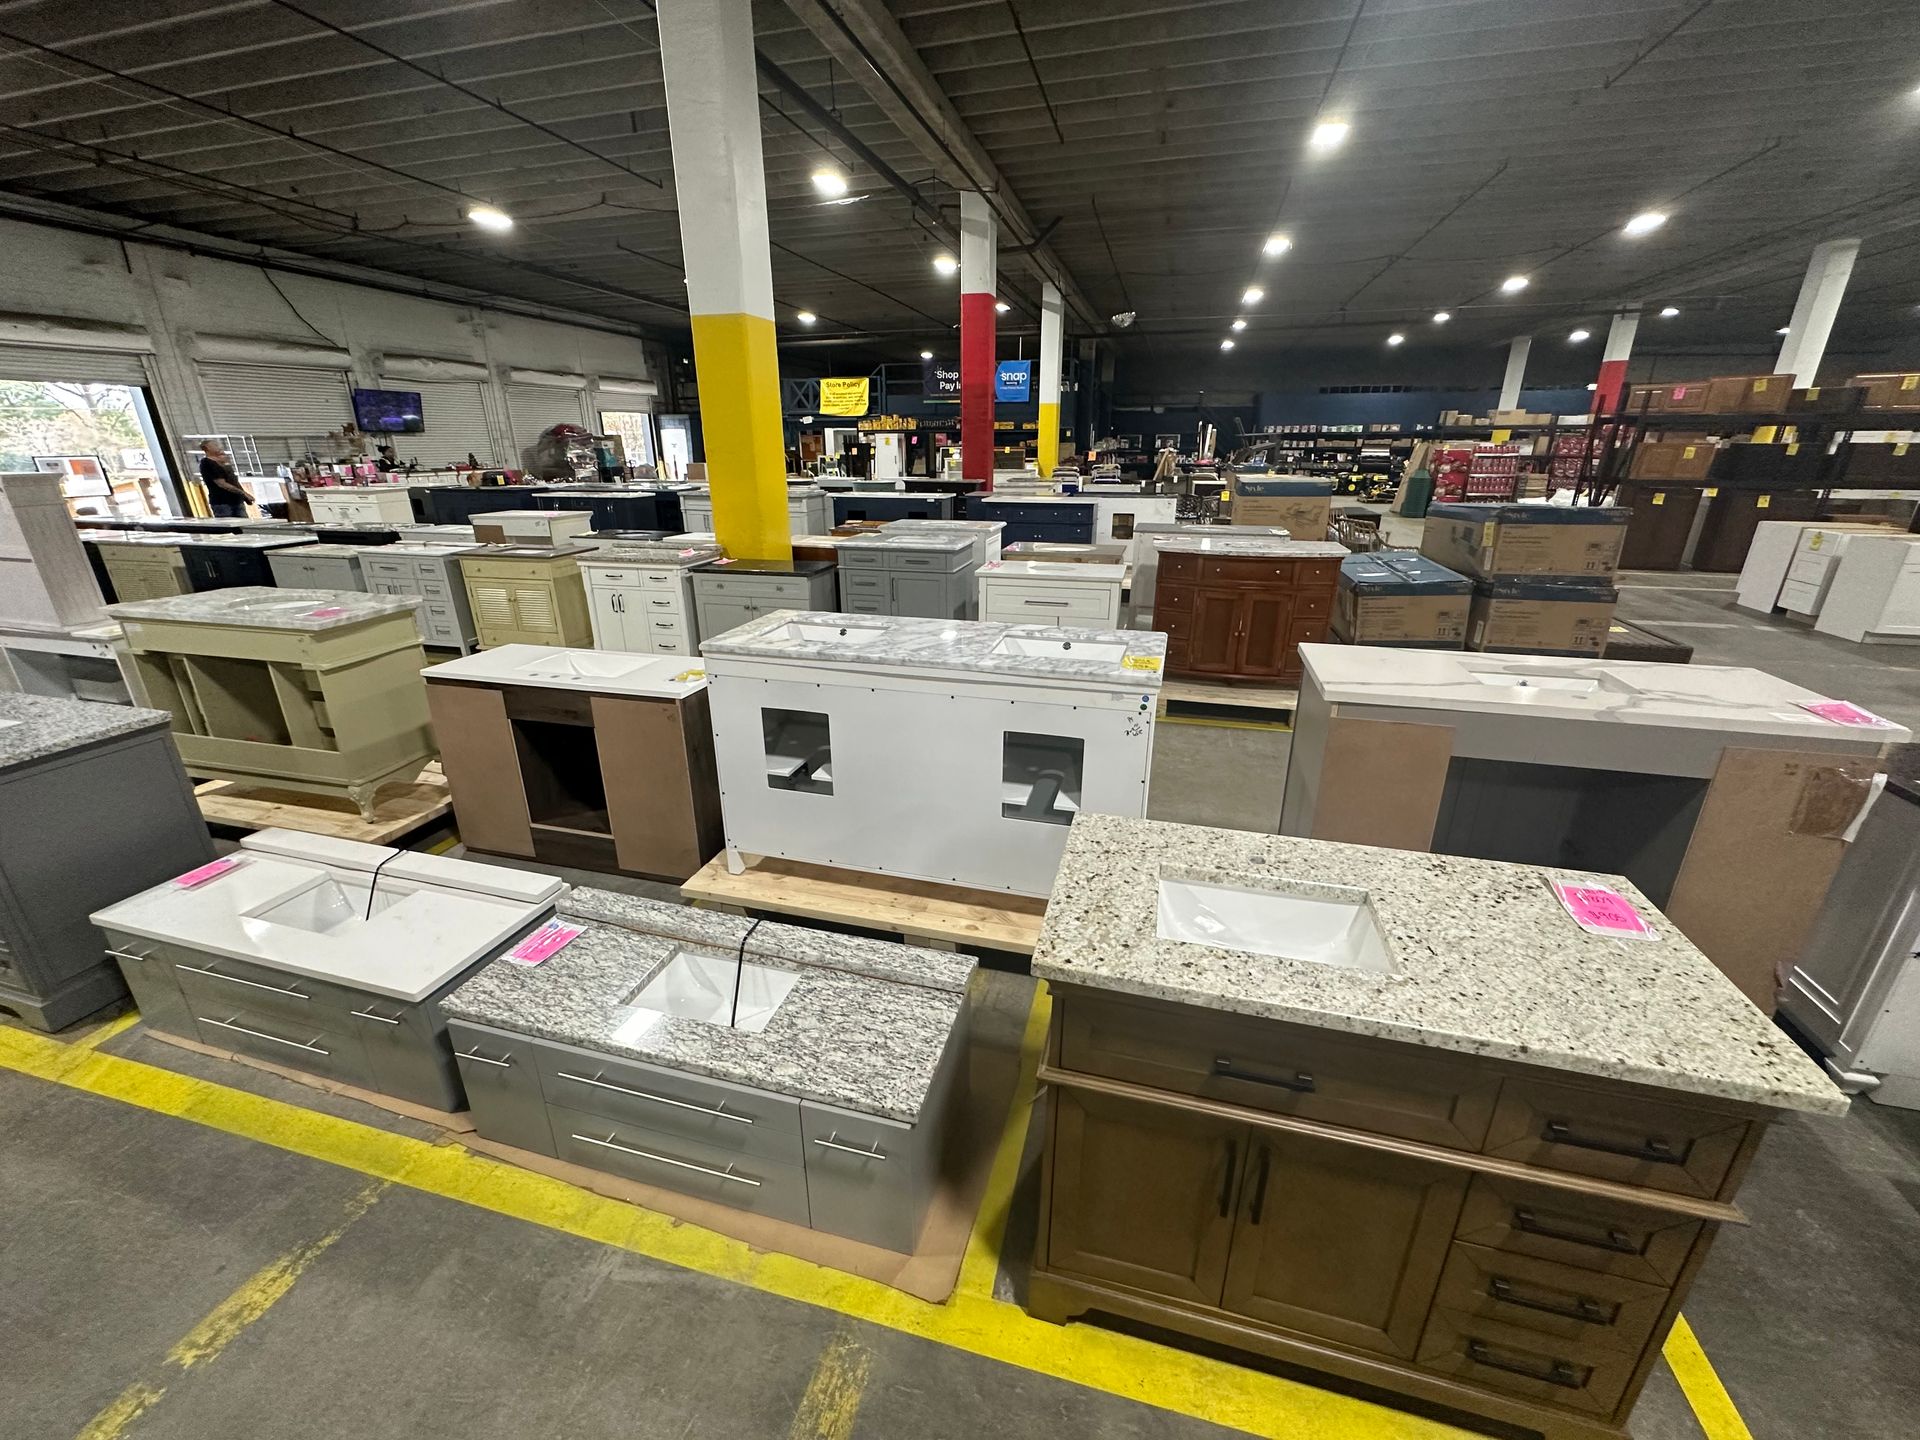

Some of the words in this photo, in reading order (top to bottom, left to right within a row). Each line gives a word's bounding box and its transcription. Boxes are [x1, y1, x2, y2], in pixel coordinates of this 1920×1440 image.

[937, 370, 959, 380] Shop
[1001, 372, 1027, 383] snap
[940, 381, 955, 391] Pay
